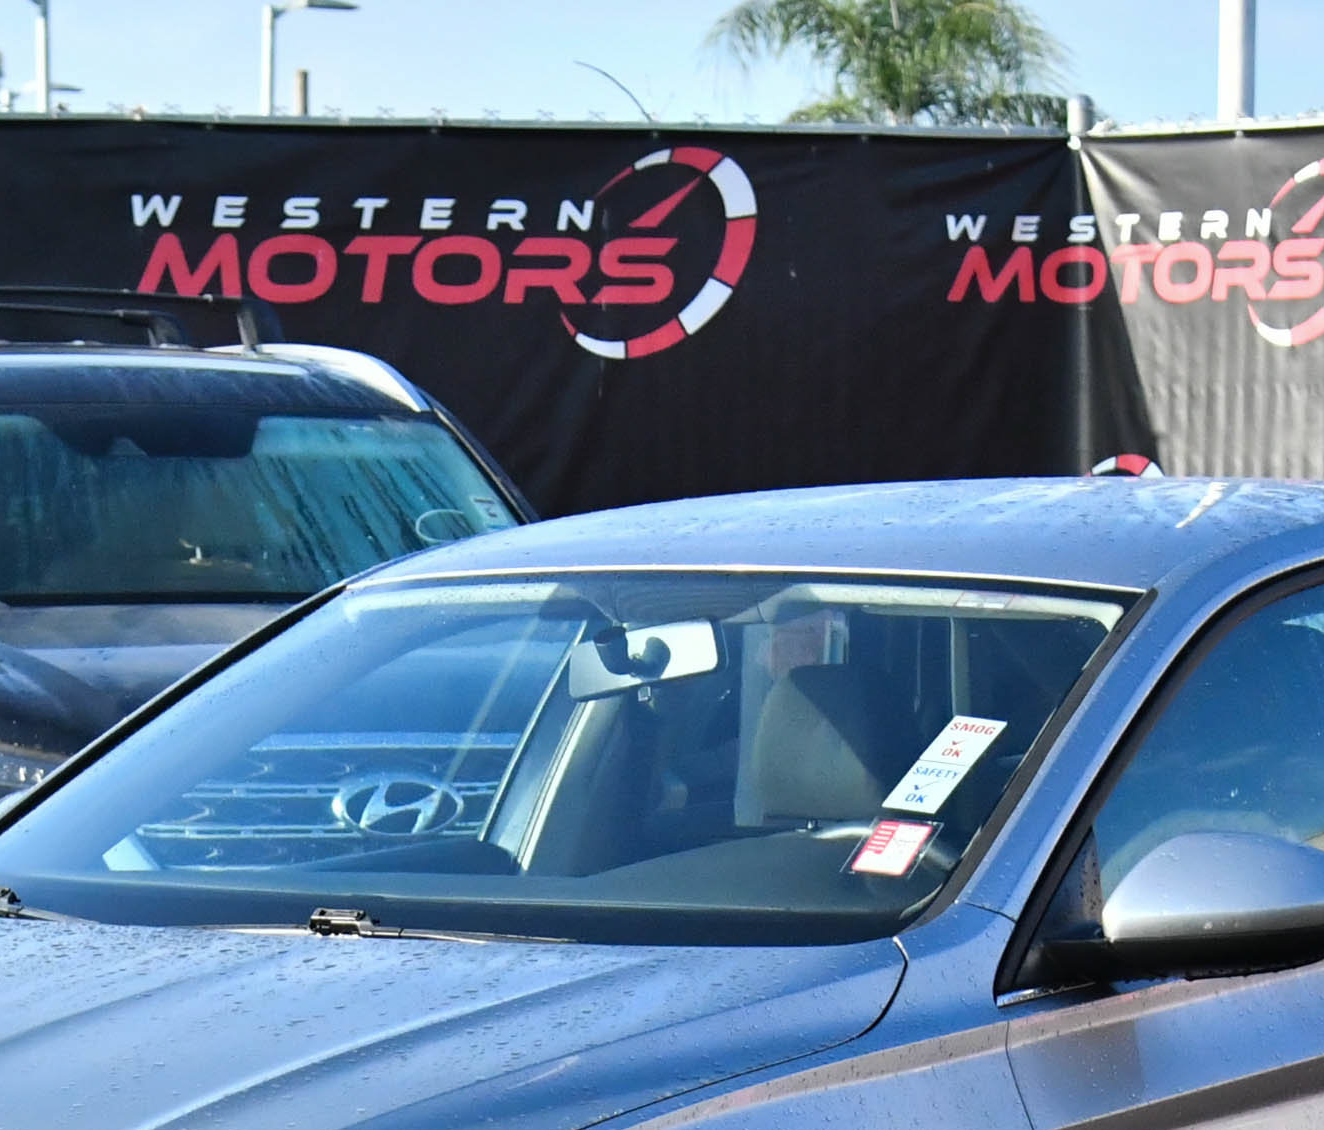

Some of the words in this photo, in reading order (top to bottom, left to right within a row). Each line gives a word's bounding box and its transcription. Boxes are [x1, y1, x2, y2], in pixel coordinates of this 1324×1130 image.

[131, 194, 595, 231] WESTERN
[945, 208, 1272, 243] WESTERN
[136, 232, 678, 305] MOTORS
[950, 722, 996, 735] SMOG
[941, 748, 962, 758] OK
[913, 766, 960, 779] SAFETY
[905, 792, 927, 803] OK
